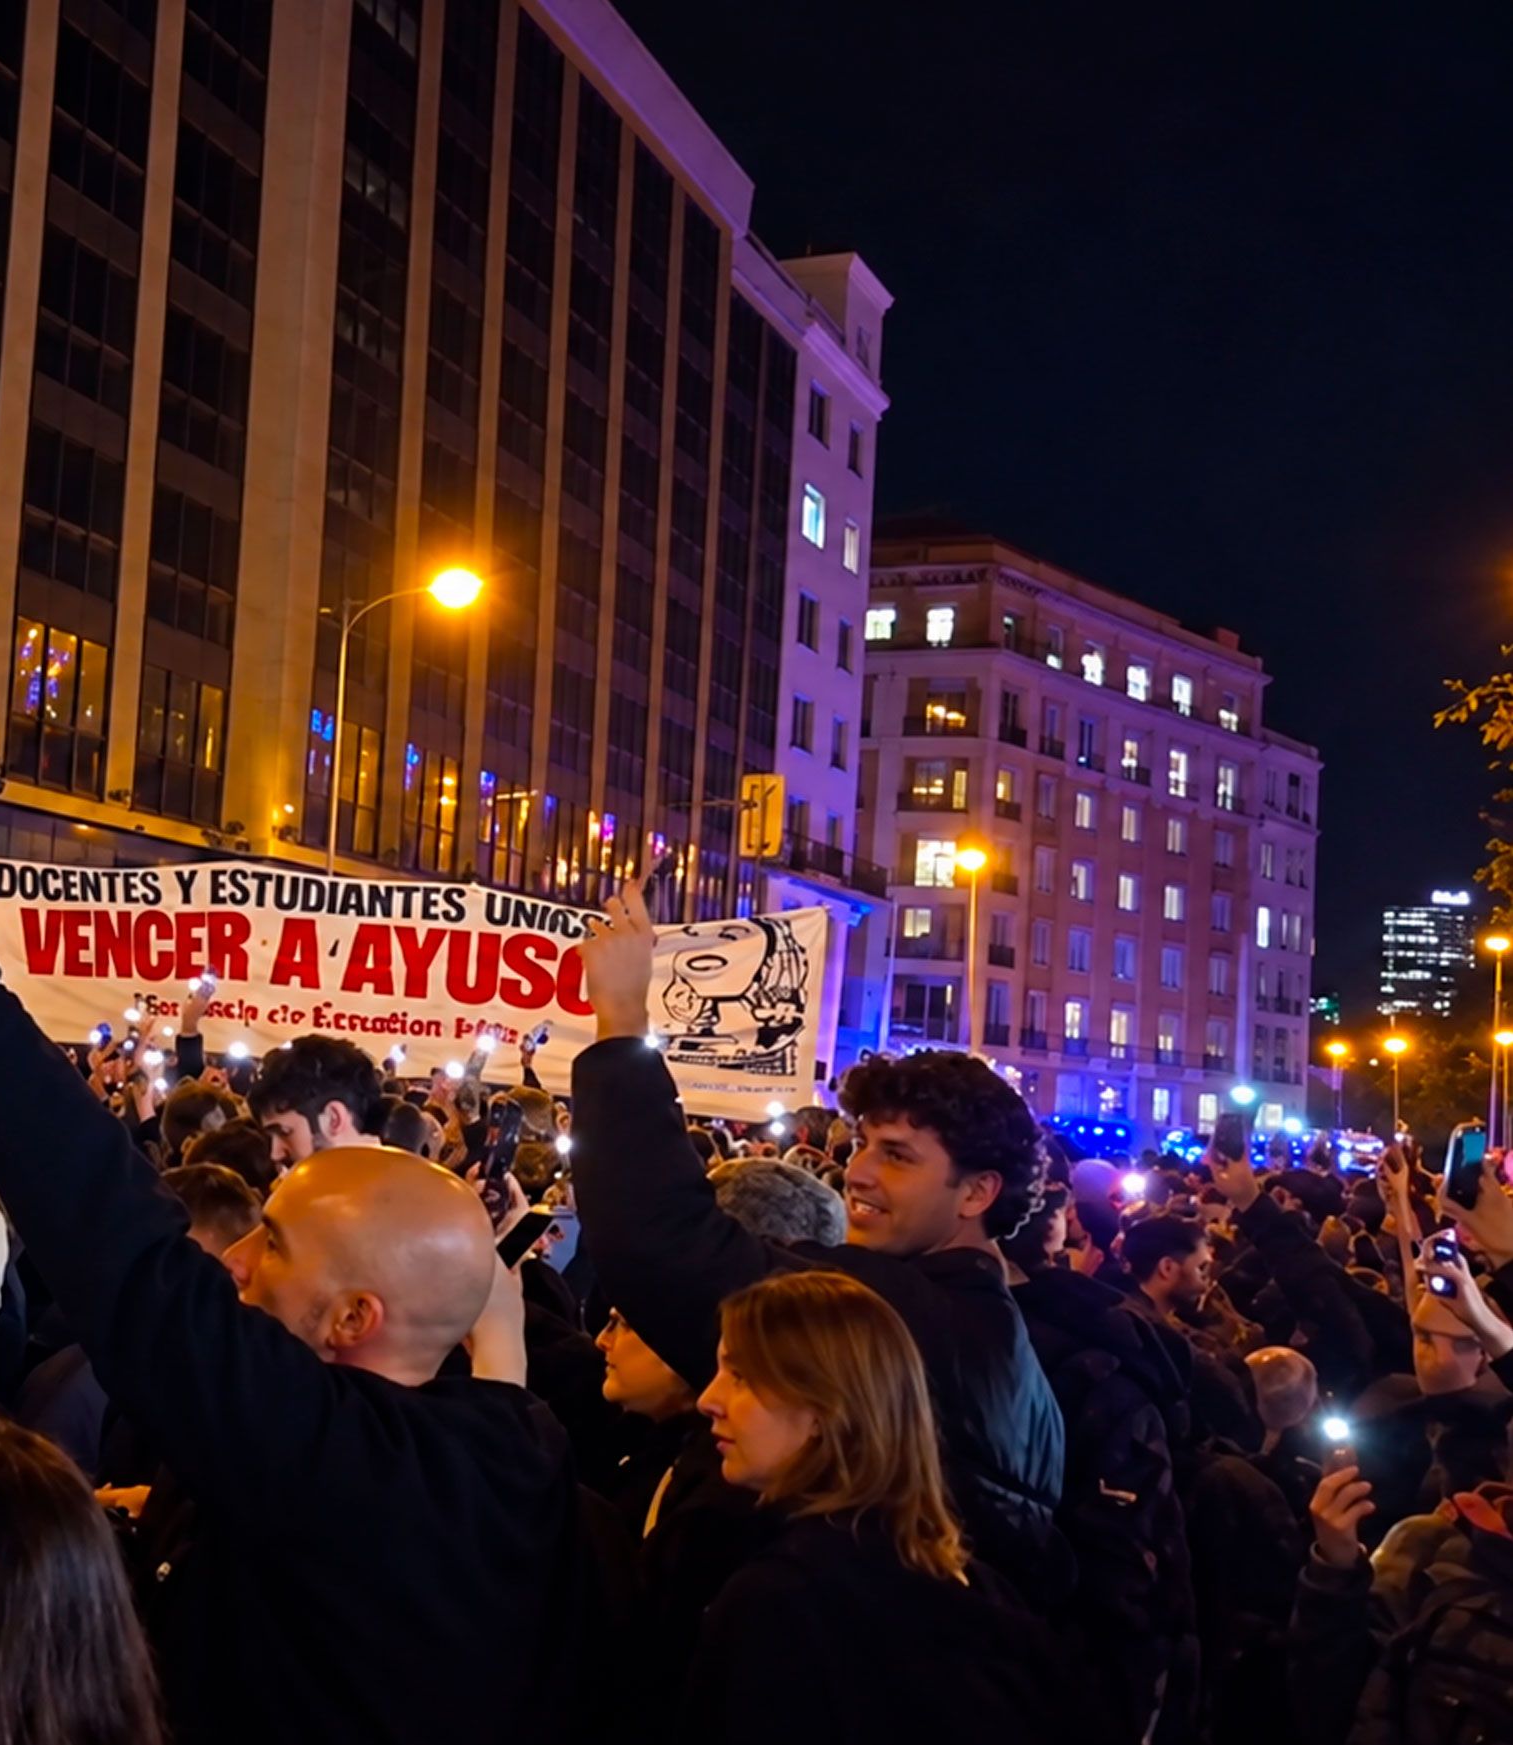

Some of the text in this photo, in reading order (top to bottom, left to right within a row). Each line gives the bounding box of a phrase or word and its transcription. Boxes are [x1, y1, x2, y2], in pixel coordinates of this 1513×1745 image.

[175, 869, 198, 905] Y
[210, 869, 466, 923] ESTUDIANTES
[20, 908, 251, 983] VENCER
[270, 917, 320, 989] A
